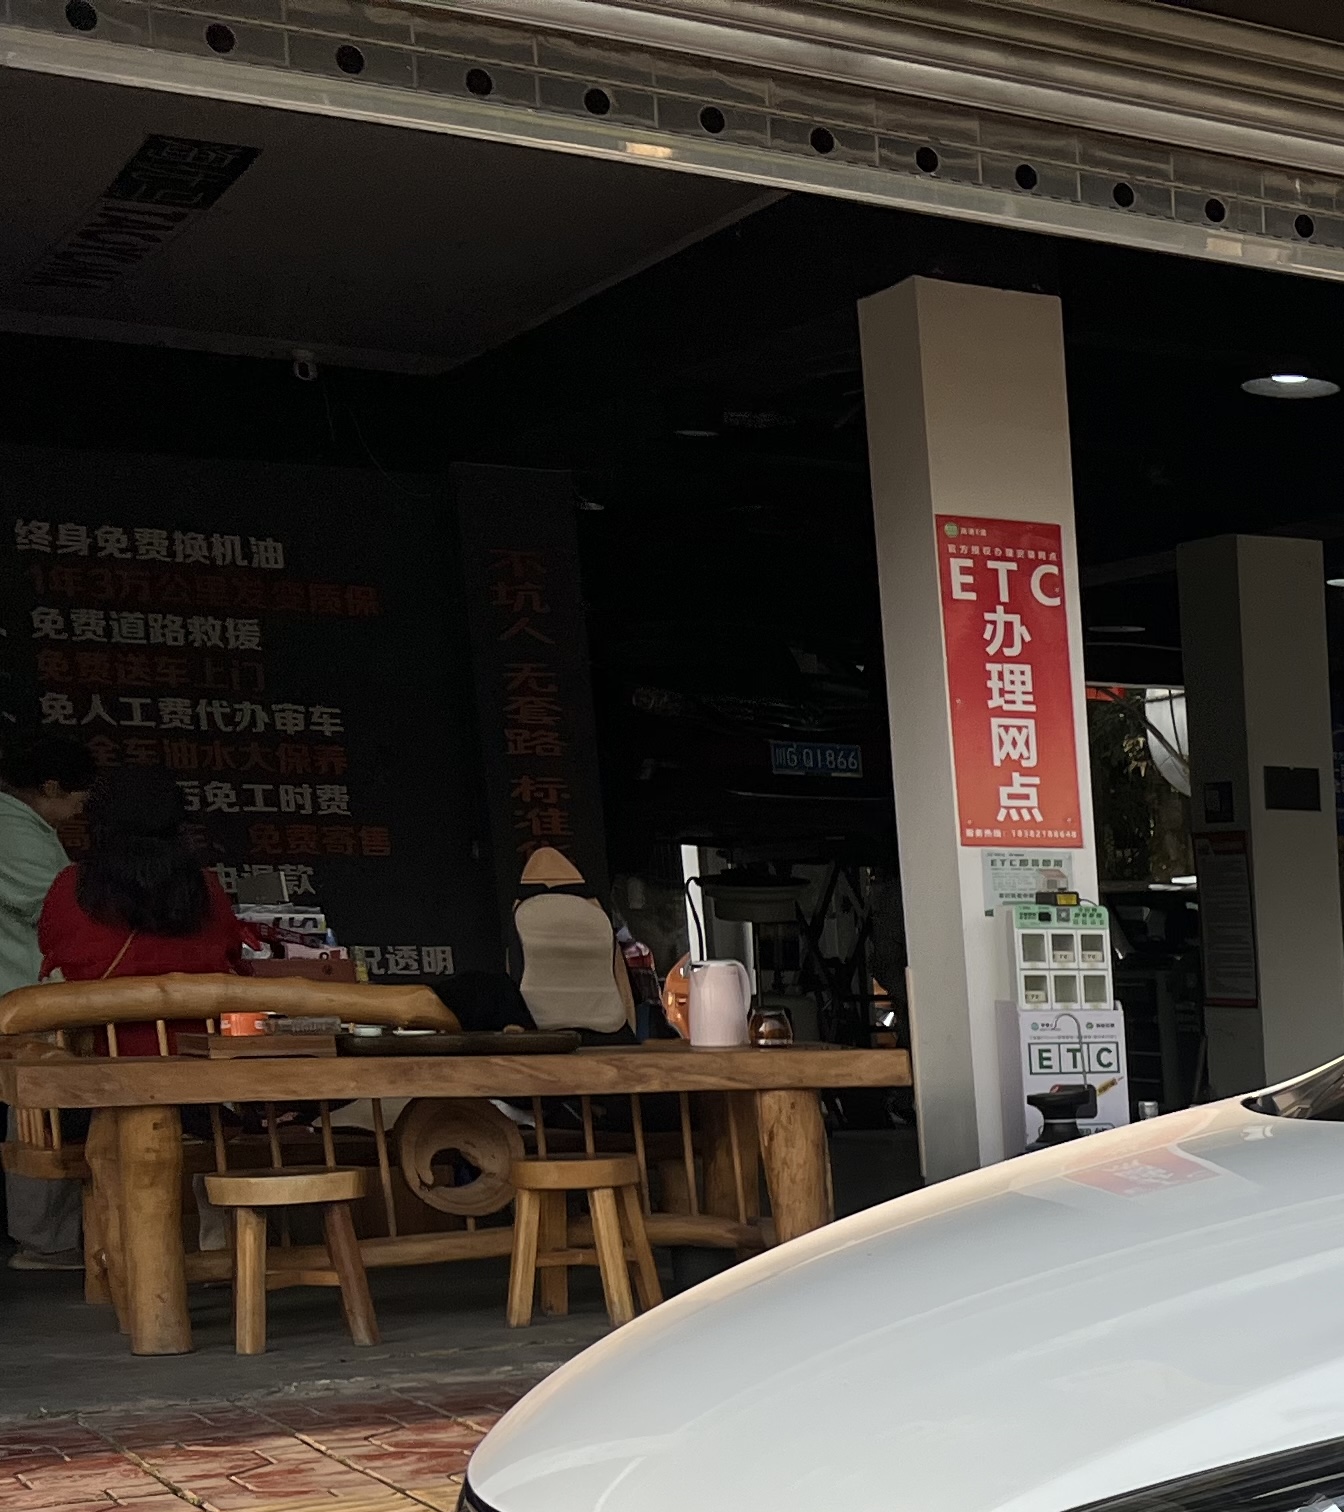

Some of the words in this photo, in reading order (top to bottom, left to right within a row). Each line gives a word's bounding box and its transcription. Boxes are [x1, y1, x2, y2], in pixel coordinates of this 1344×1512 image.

[15, 518, 286, 570] 终身免费换机油
[949, 557, 1062, 608] ETC
[31, 606, 263, 651] 免费道路救援
[36, 648, 265, 693] 免费送车上门
[39, 692, 346, 737] 免人工费代办审车
[983, 605, 1044, 823] 办理网点
[1037, 1047, 1114, 1070] ETC
